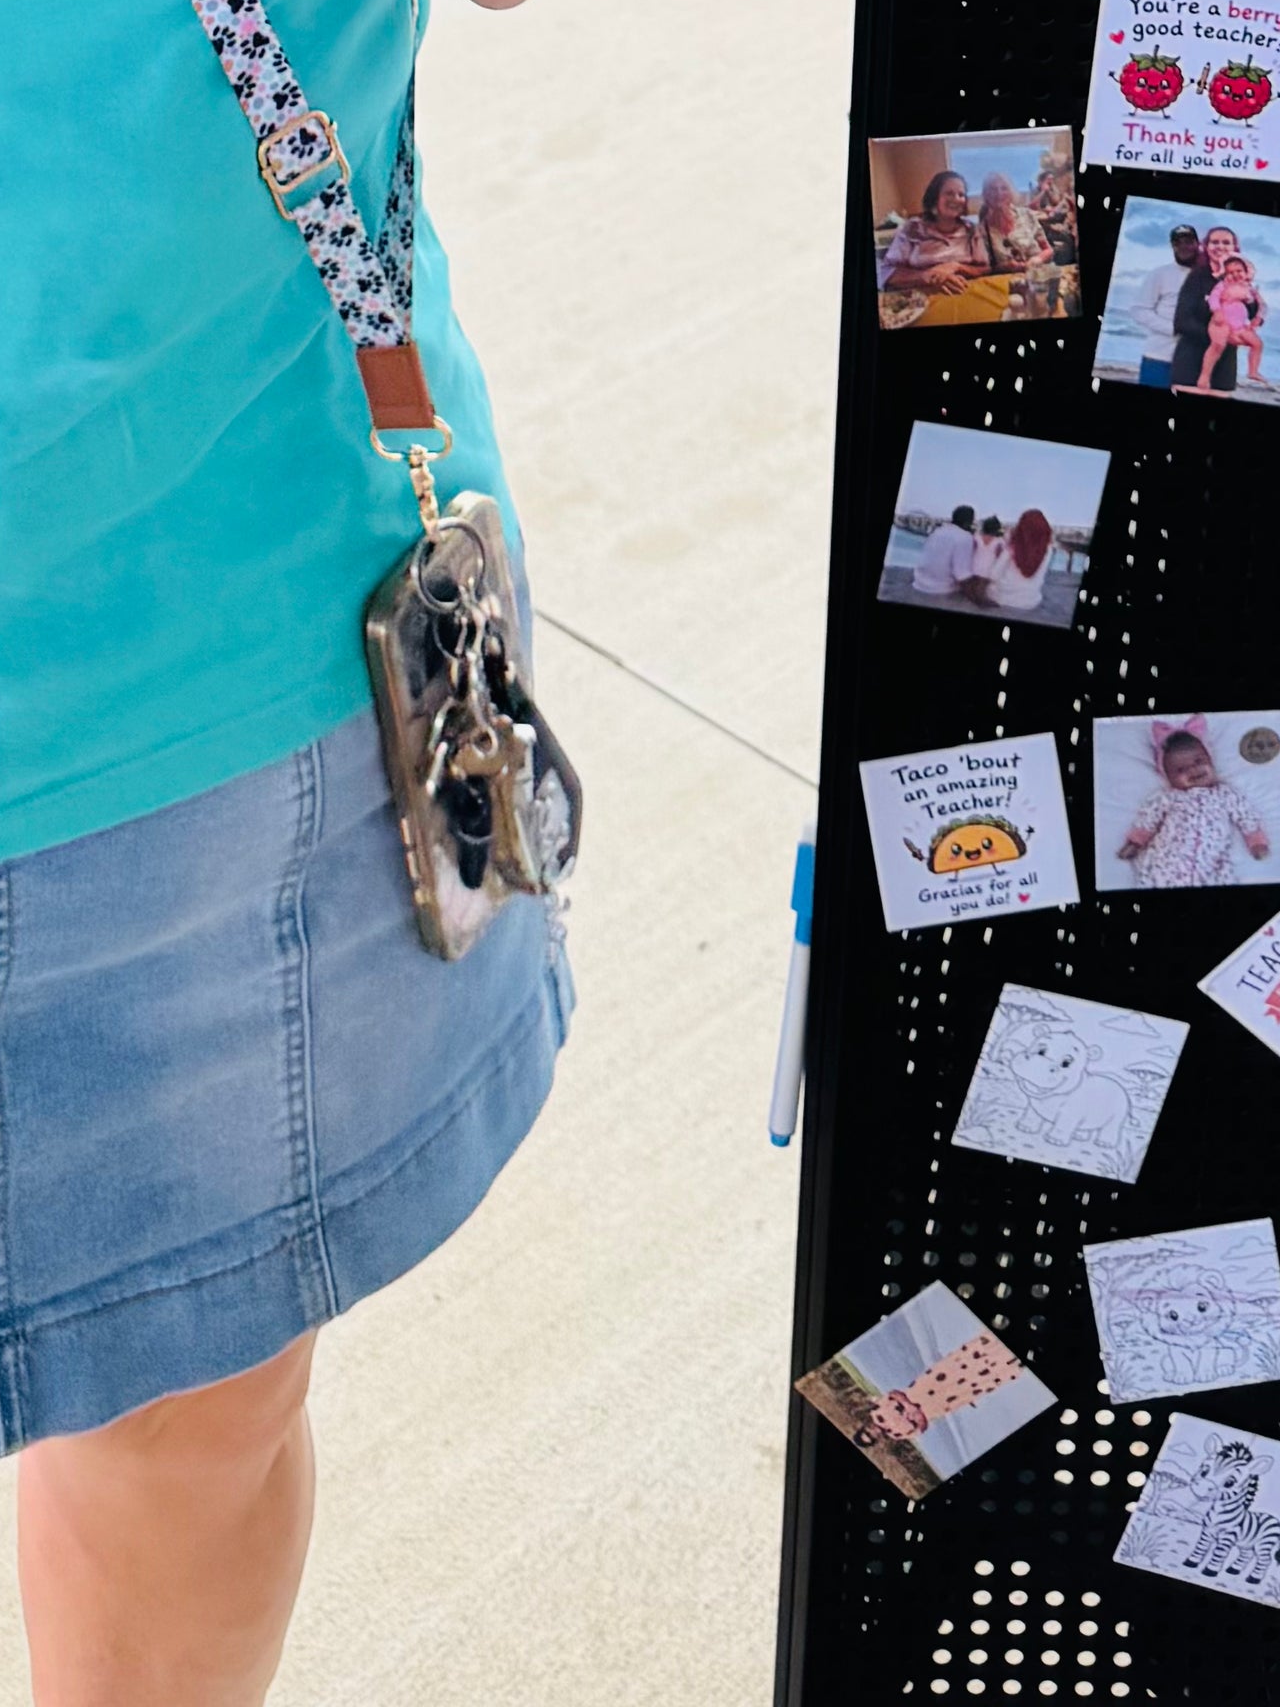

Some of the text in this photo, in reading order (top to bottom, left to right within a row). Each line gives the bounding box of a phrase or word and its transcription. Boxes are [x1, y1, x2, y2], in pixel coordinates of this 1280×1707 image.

[1208, 5, 1221, 15] a
[1133, 20, 1184, 42] good
[1122, 123, 1243, 153] Thank you
[1115, 144, 1249, 170] for all you do!
[891, 753, 1022, 786] Taco 'bout
[904, 774, 1018, 803] an amazing
[921, 792, 1012, 819] Teacher!
[918, 872, 1038, 903] Gracias for all
[950, 892, 1010, 916] you do!
